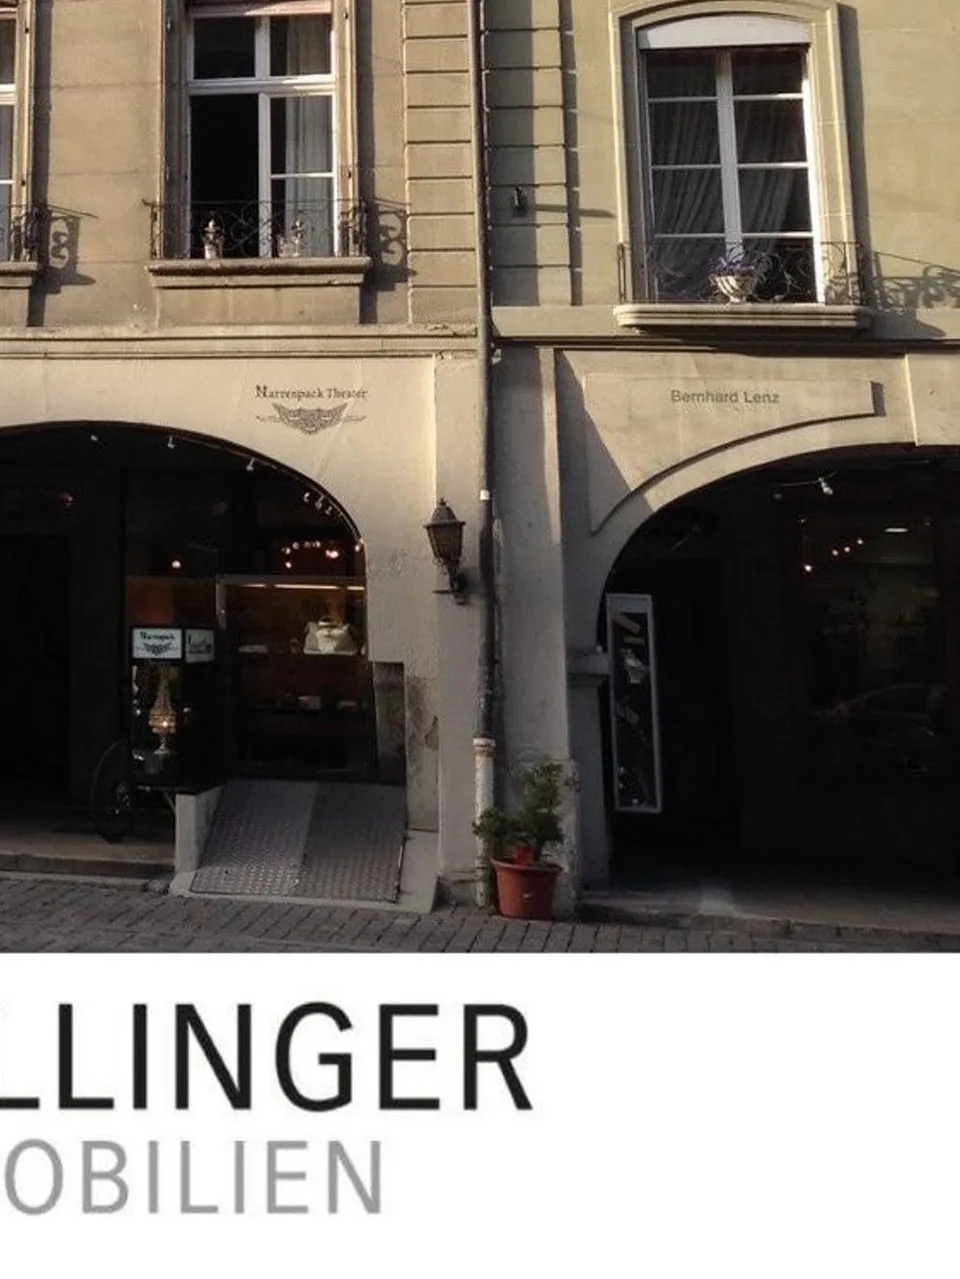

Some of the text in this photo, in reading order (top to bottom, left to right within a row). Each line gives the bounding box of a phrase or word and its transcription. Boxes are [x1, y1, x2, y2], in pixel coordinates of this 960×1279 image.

[255, 384, 368, 401] Narrenpack Theater
[670, 389, 780, 404] Bernhard Lenz
